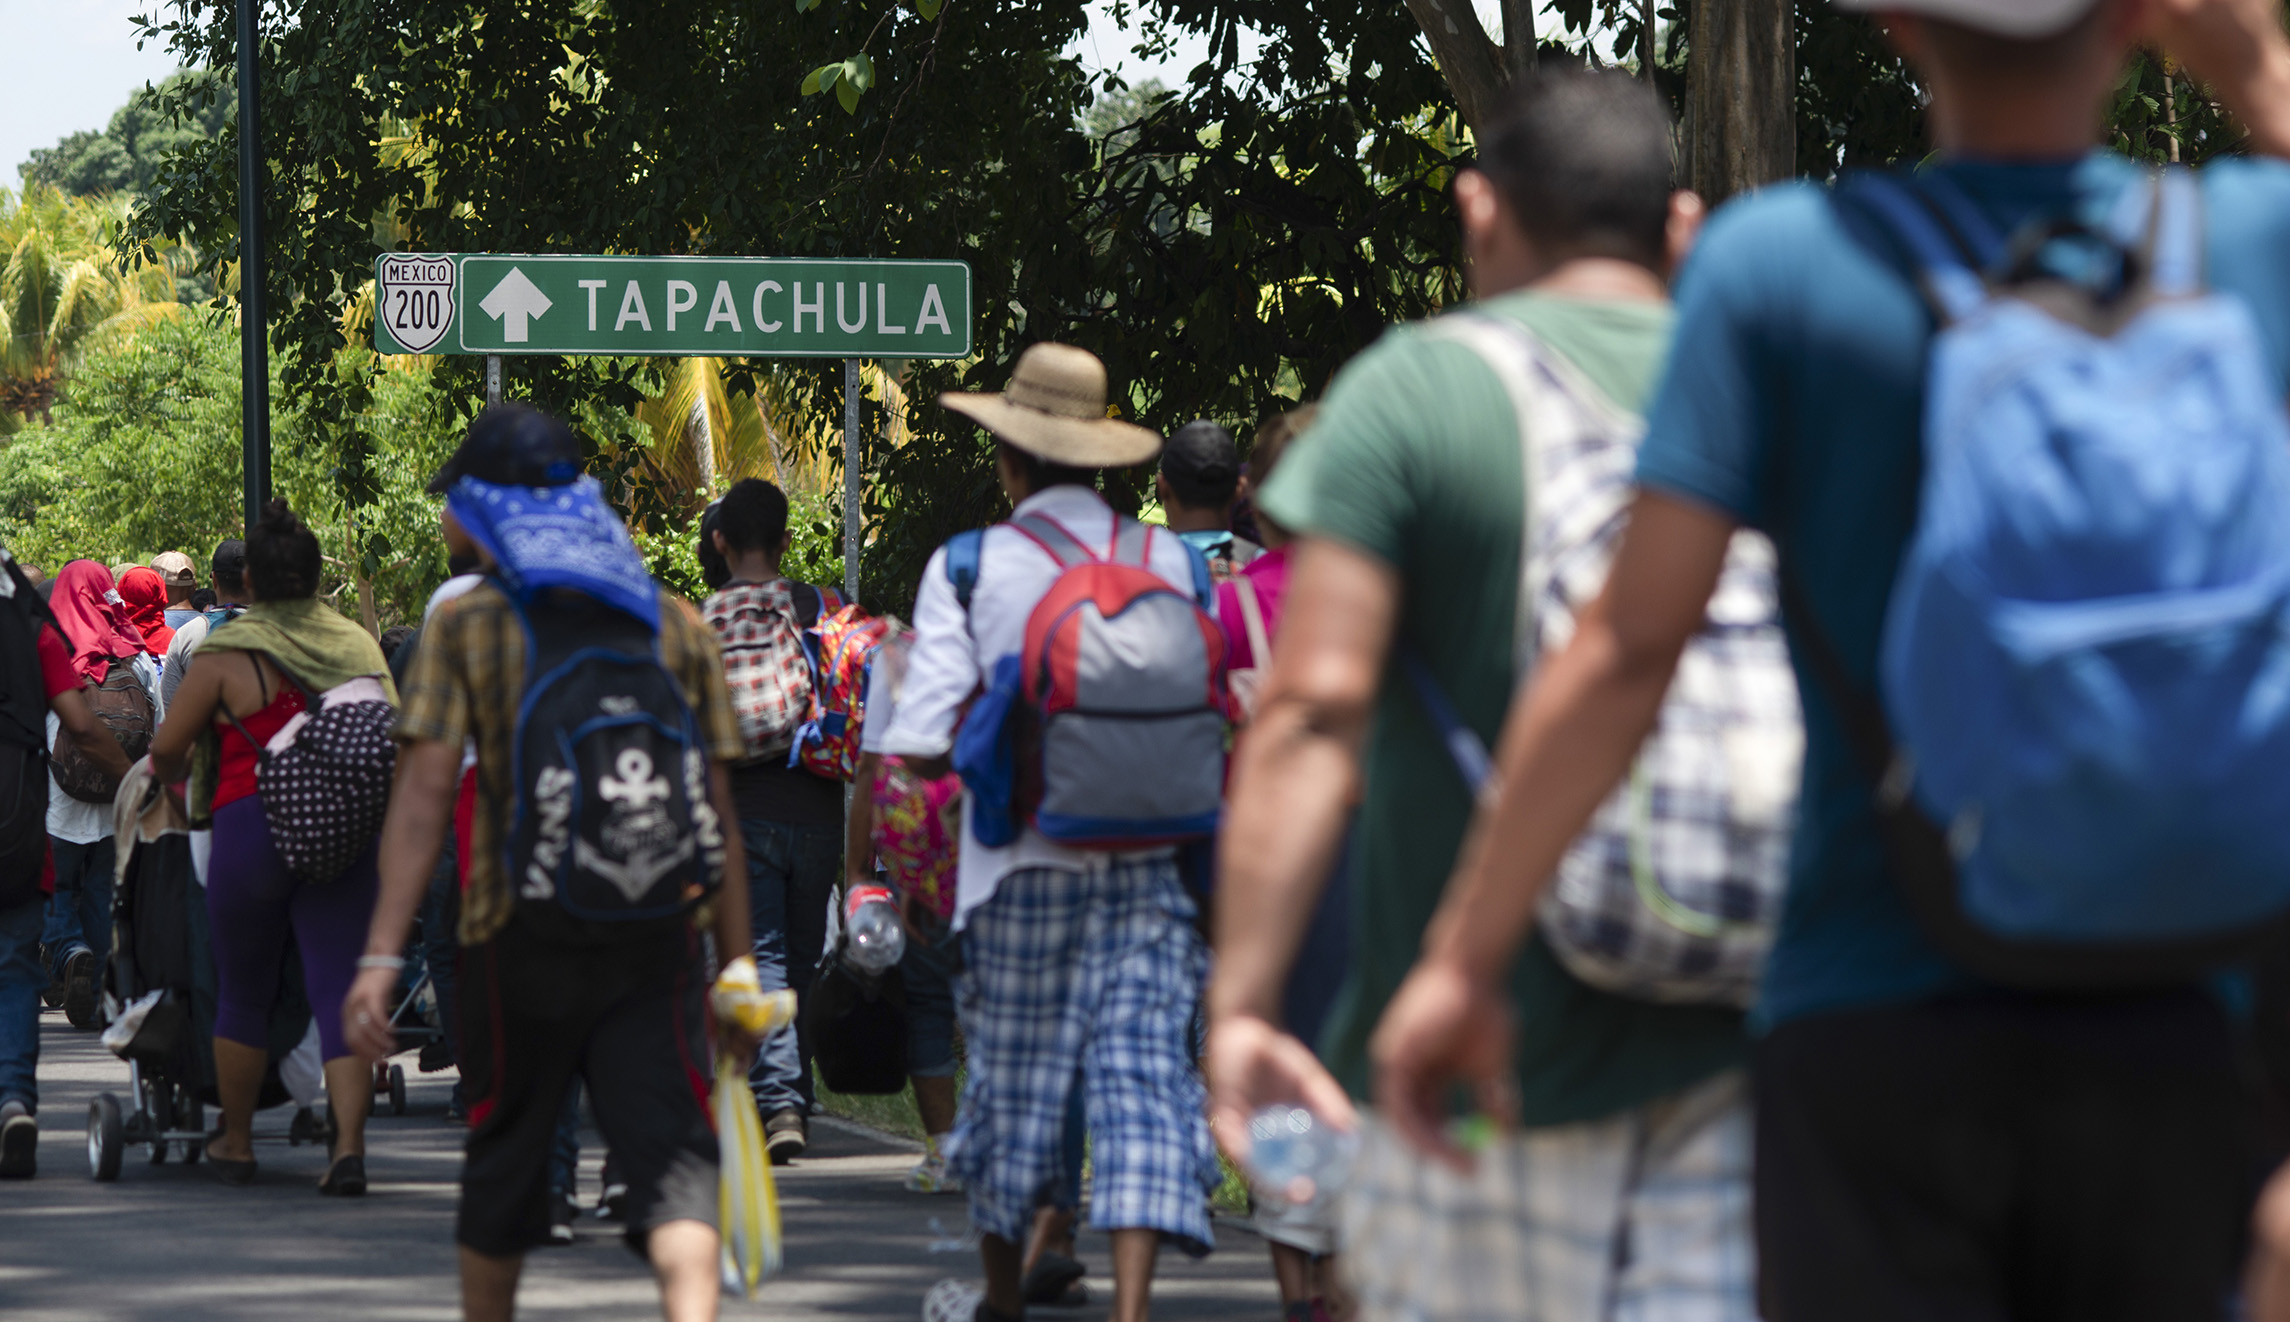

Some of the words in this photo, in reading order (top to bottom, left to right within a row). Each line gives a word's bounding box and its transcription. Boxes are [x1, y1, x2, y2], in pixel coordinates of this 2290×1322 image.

[389, 264, 446, 281] MEXICO
[396, 289, 440, 330] 200
[578, 279, 952, 335] TAPACHULA
